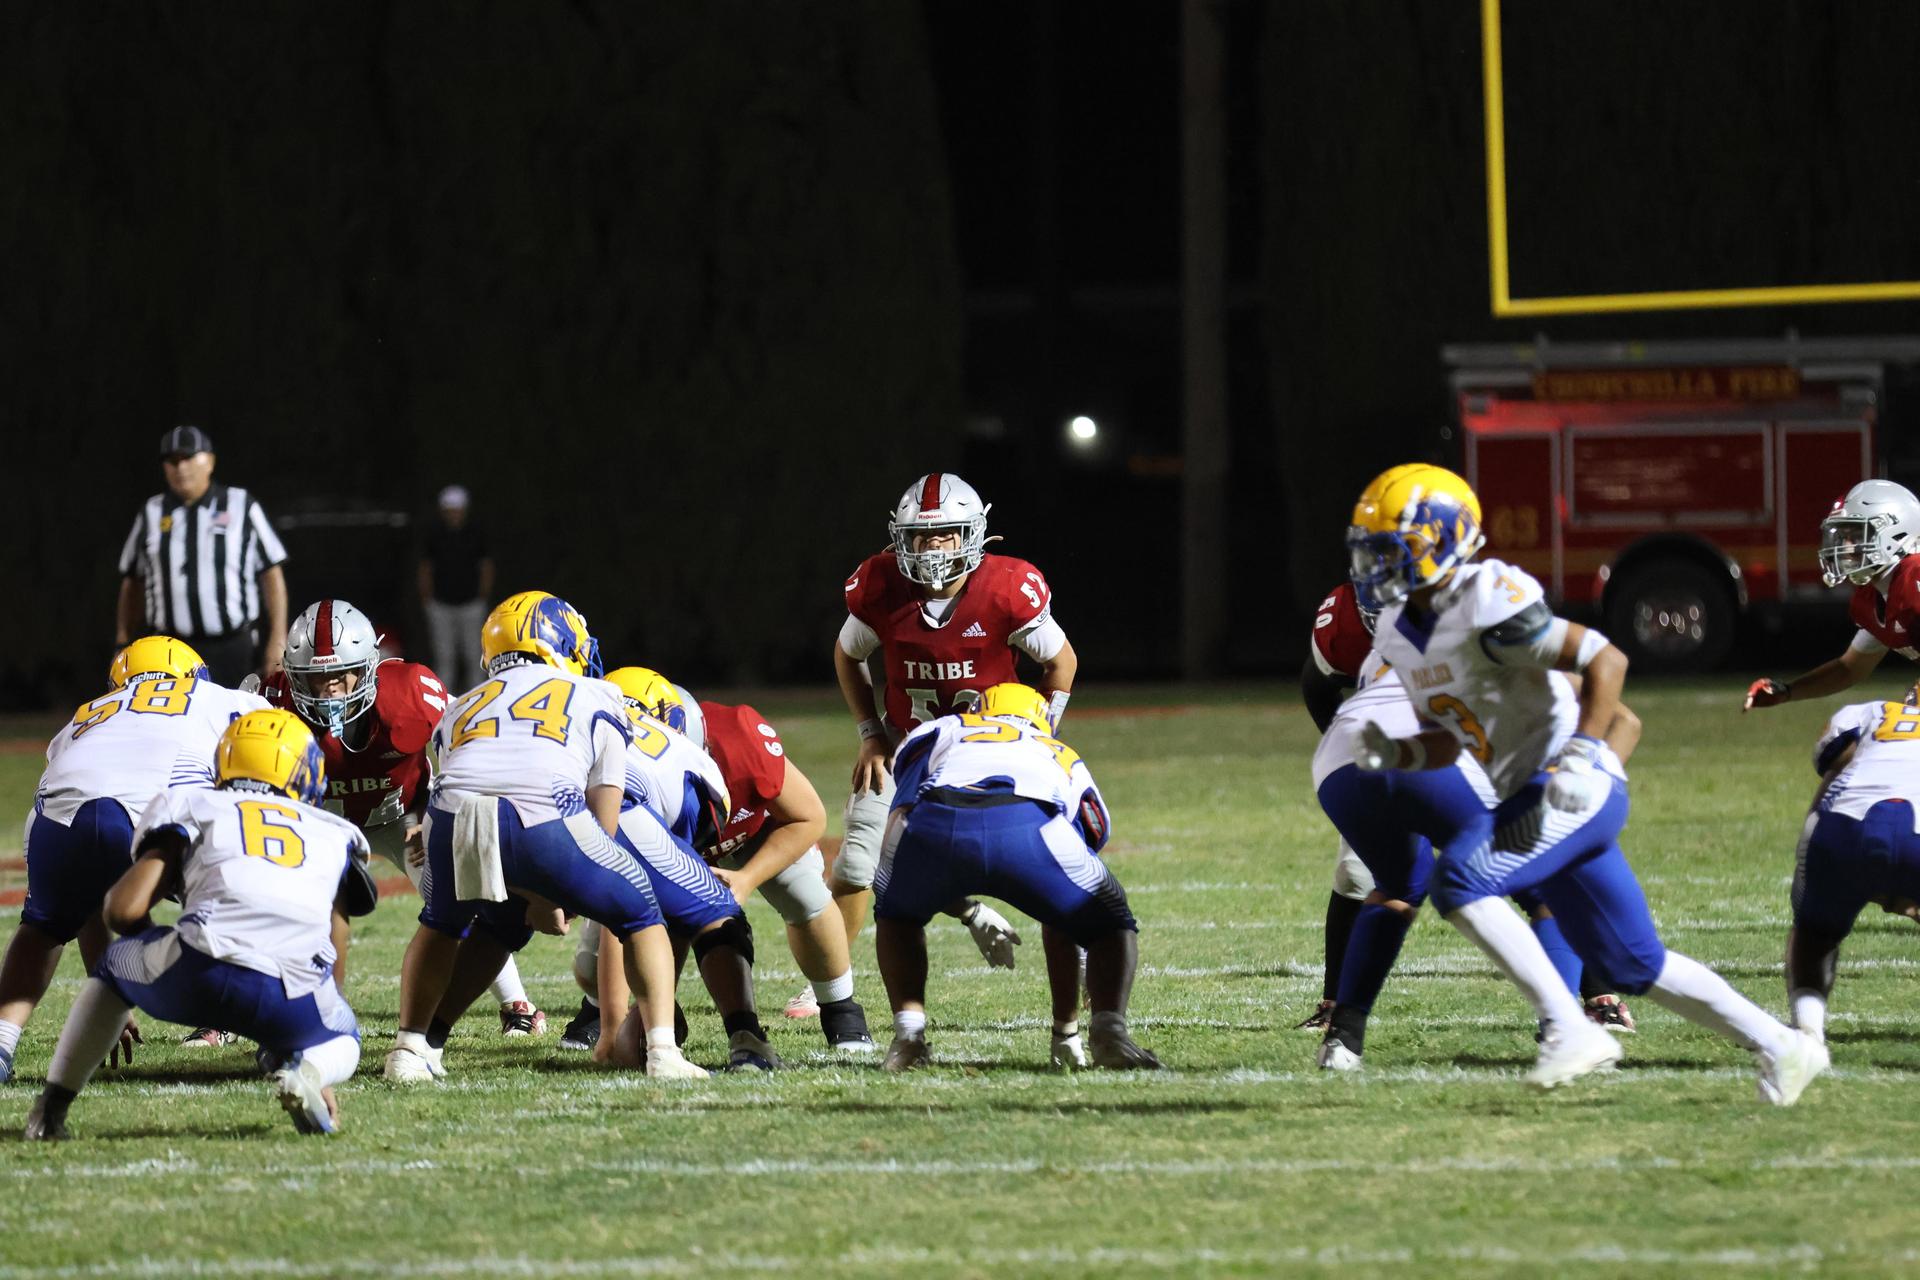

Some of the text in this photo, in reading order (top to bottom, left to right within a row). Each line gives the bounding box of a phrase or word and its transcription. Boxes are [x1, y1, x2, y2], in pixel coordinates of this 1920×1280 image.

[1493, 575, 1526, 604] 3
[961, 630, 987, 638] adidas
[313, 657, 338, 665] Riddell
[904, 660, 976, 680] TRIBE
[131, 671, 167, 683] schutt
[72, 677, 198, 740] 58
[448, 677, 576, 752] 24
[1427, 693, 1494, 765] 3
[330, 777, 393, 797] RIBE
[235, 800, 306, 869] 6
